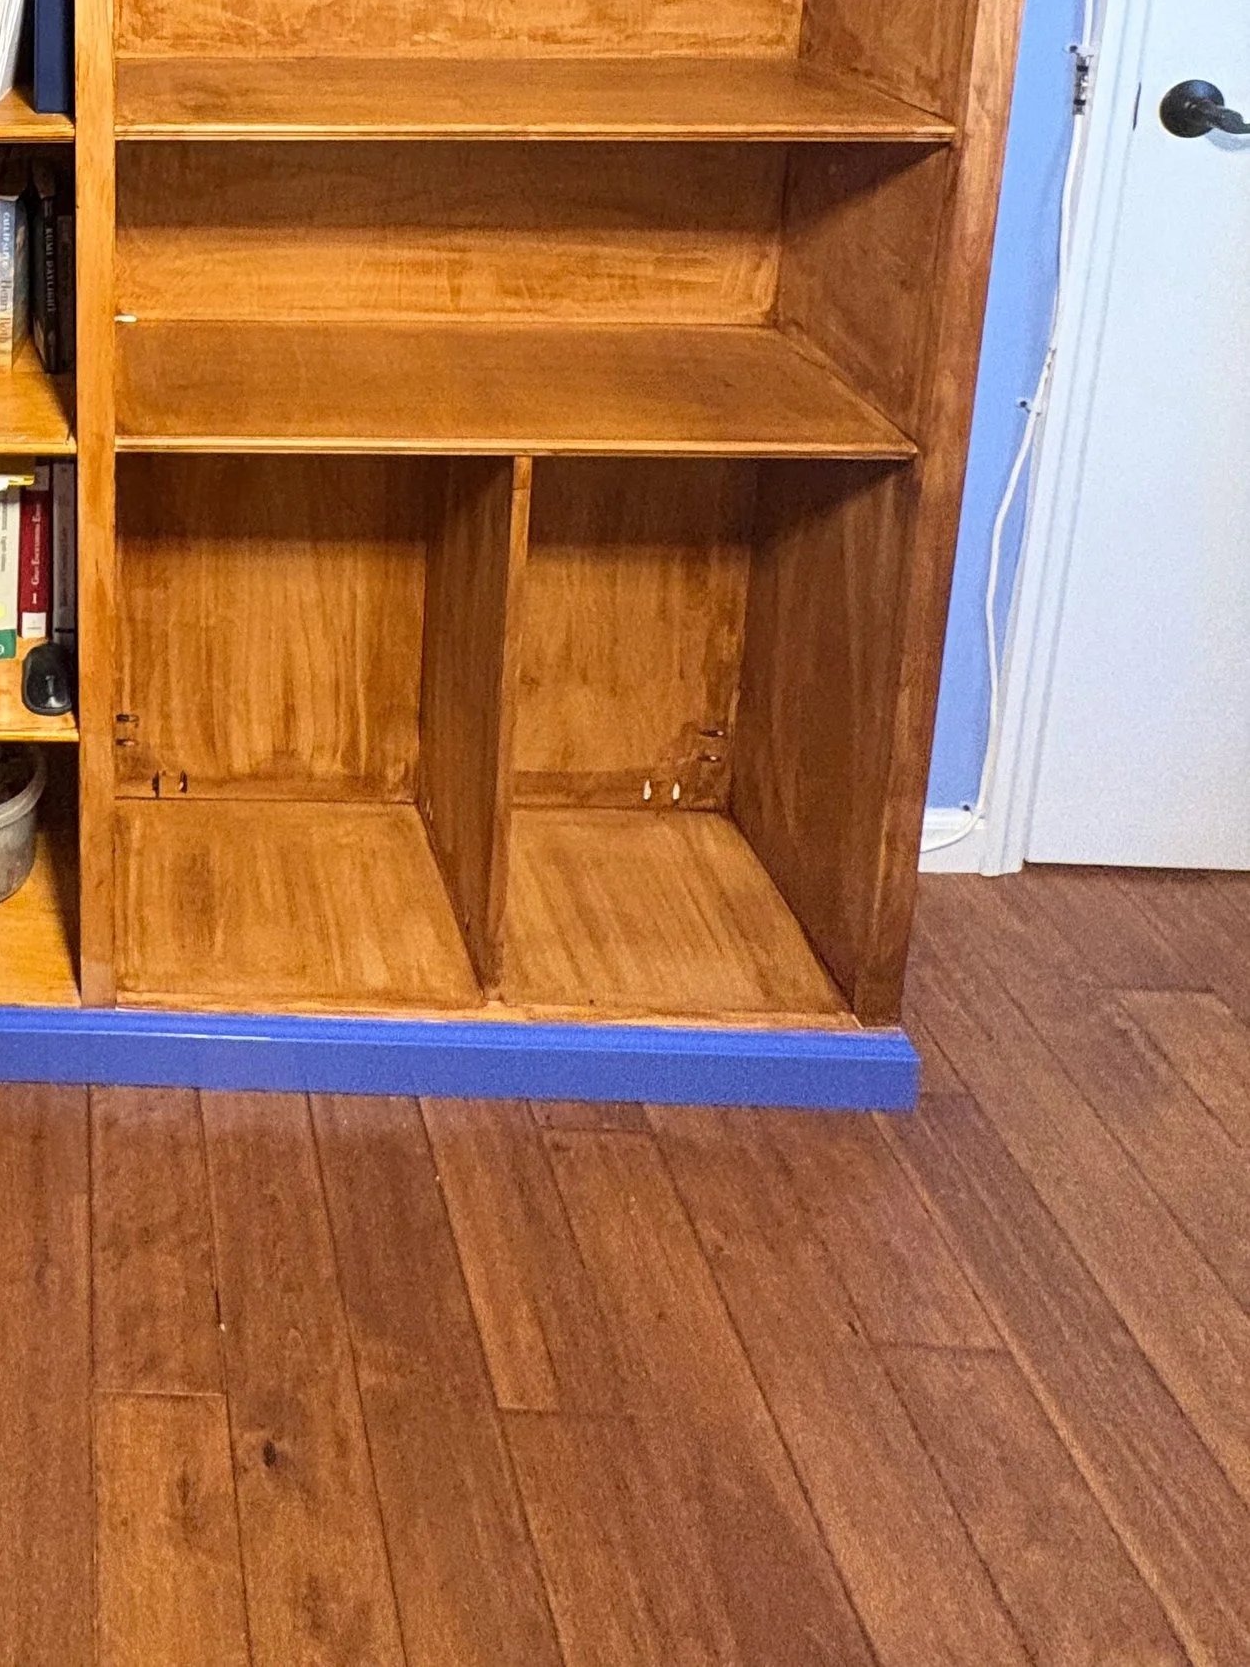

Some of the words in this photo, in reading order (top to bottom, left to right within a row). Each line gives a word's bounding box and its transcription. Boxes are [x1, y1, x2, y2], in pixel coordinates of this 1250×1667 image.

[45, 228, 54, 255] RUMI
[46, 260, 56, 313] DAYLIGHT
[0, 317, 12, 344] Roth
